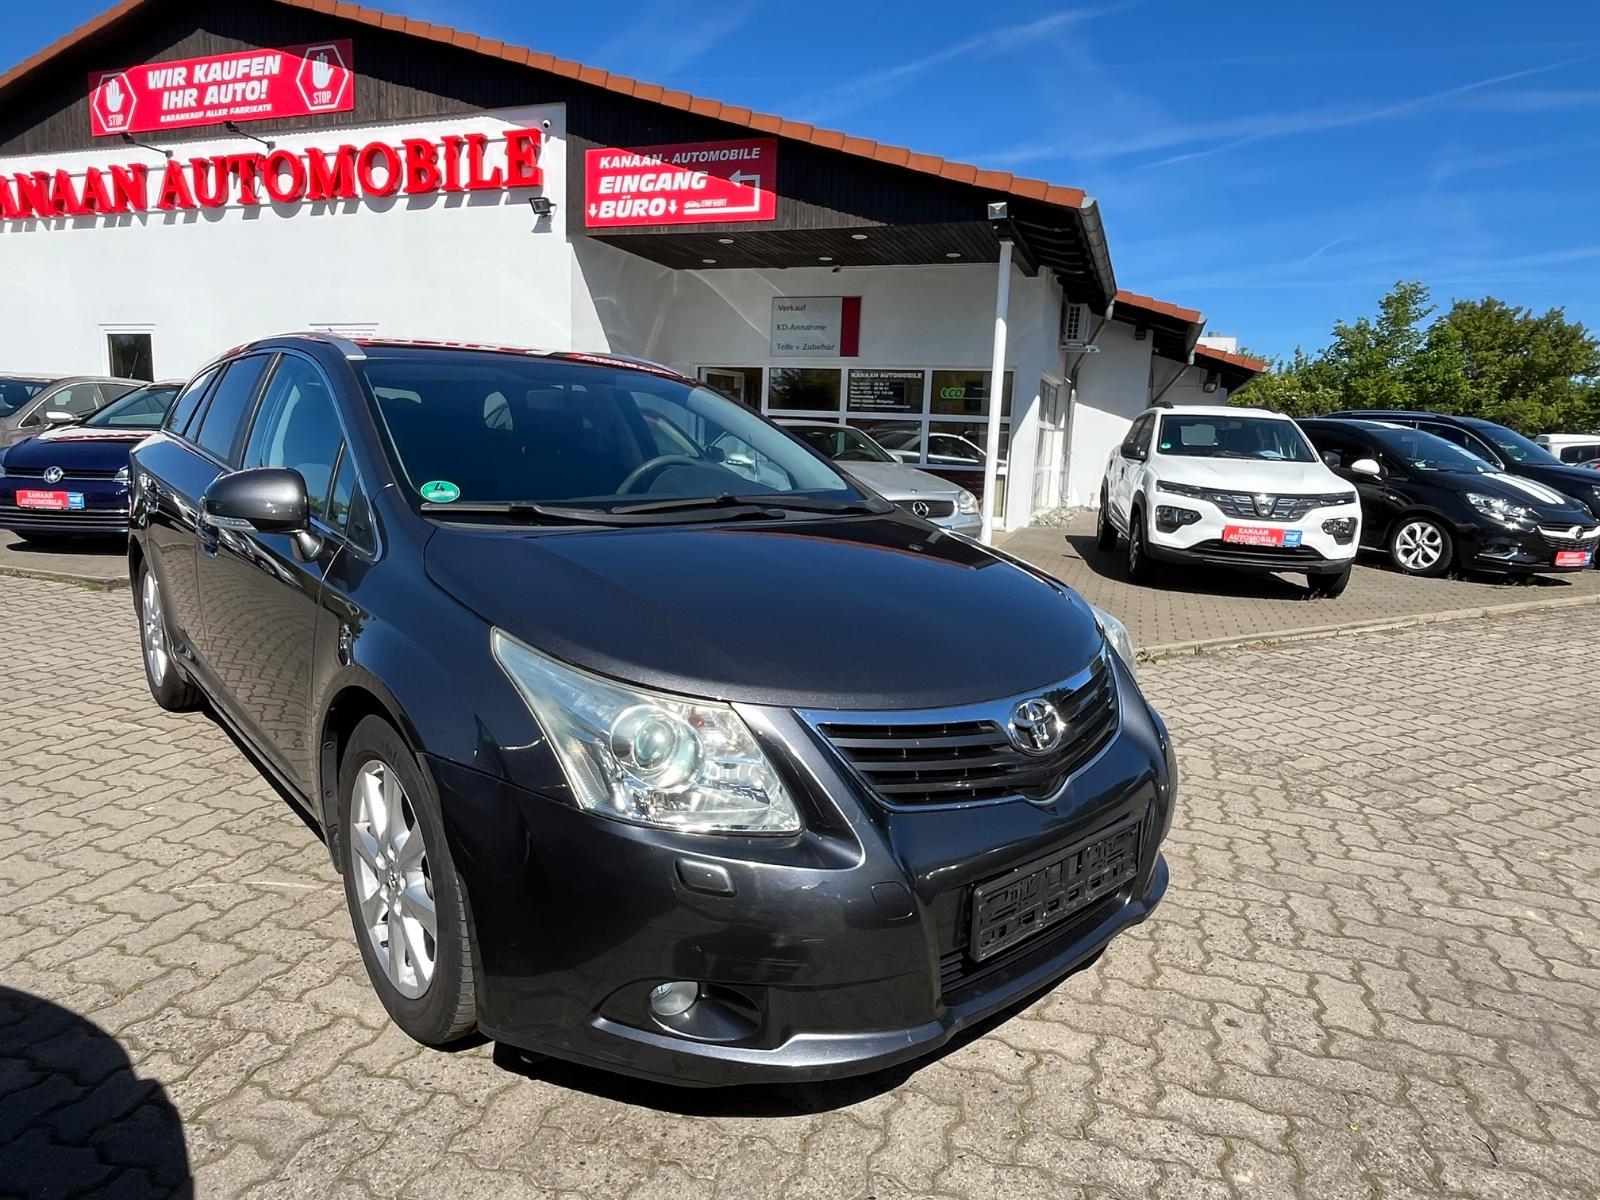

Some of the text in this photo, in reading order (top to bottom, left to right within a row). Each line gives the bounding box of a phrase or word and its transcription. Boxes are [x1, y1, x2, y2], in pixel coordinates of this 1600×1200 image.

[148, 55, 282, 90] WIR KAUFEN
[162, 79, 268, 111] IHR AUTO!
[313, 92, 332, 105] STOP
[205, 108, 228, 118] ALLER
[230, 103, 273, 115] FABRIKATE
[108, 114, 124, 127] STOP
[600, 153, 662, 169] KANAAN
[672, 147, 761, 164] AUTOMOBILE
[0, 128, 544, 219] ANAAN AUTOMOBILE
[598, 171, 709, 194] EINGANG
[598, 195, 667, 219] BÜRO
[777, 303, 807, 312] Verkauf
[776, 324, 827, 332] KD-Annahme
[777, 342, 794, 351] Teile
[434, 482, 445, 492] 4
[1228, 534, 1276, 543] AUTOMOBILE
